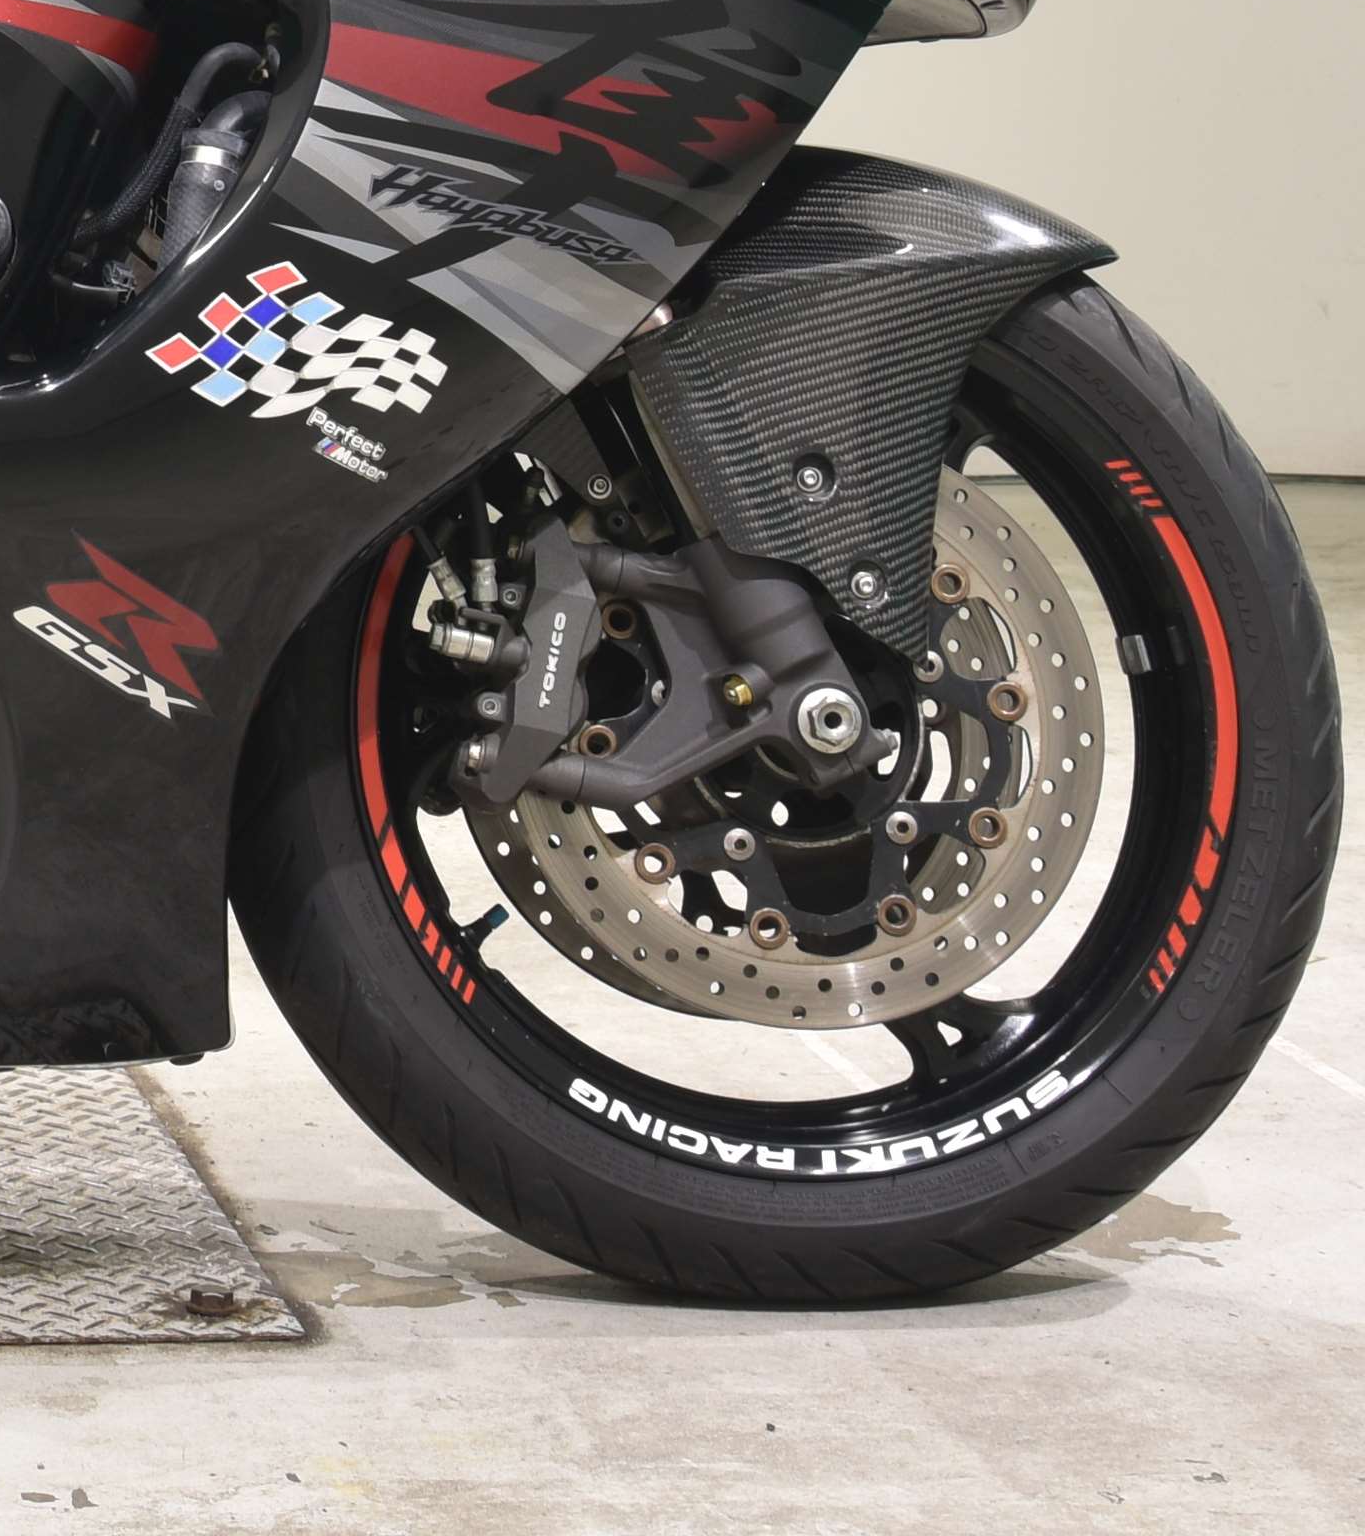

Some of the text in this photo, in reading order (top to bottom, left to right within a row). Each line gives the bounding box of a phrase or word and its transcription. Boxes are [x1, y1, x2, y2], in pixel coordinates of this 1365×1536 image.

[367, 163, 646, 266] Hayabusa
[306, 406, 386, 461] Perfect
[12, 605, 199, 720] GSX
[538, 611, 567, 709] TOKICO
[568, 1077, 796, 1172] RACING
[813, 1069, 1070, 1175] SUZUKI
